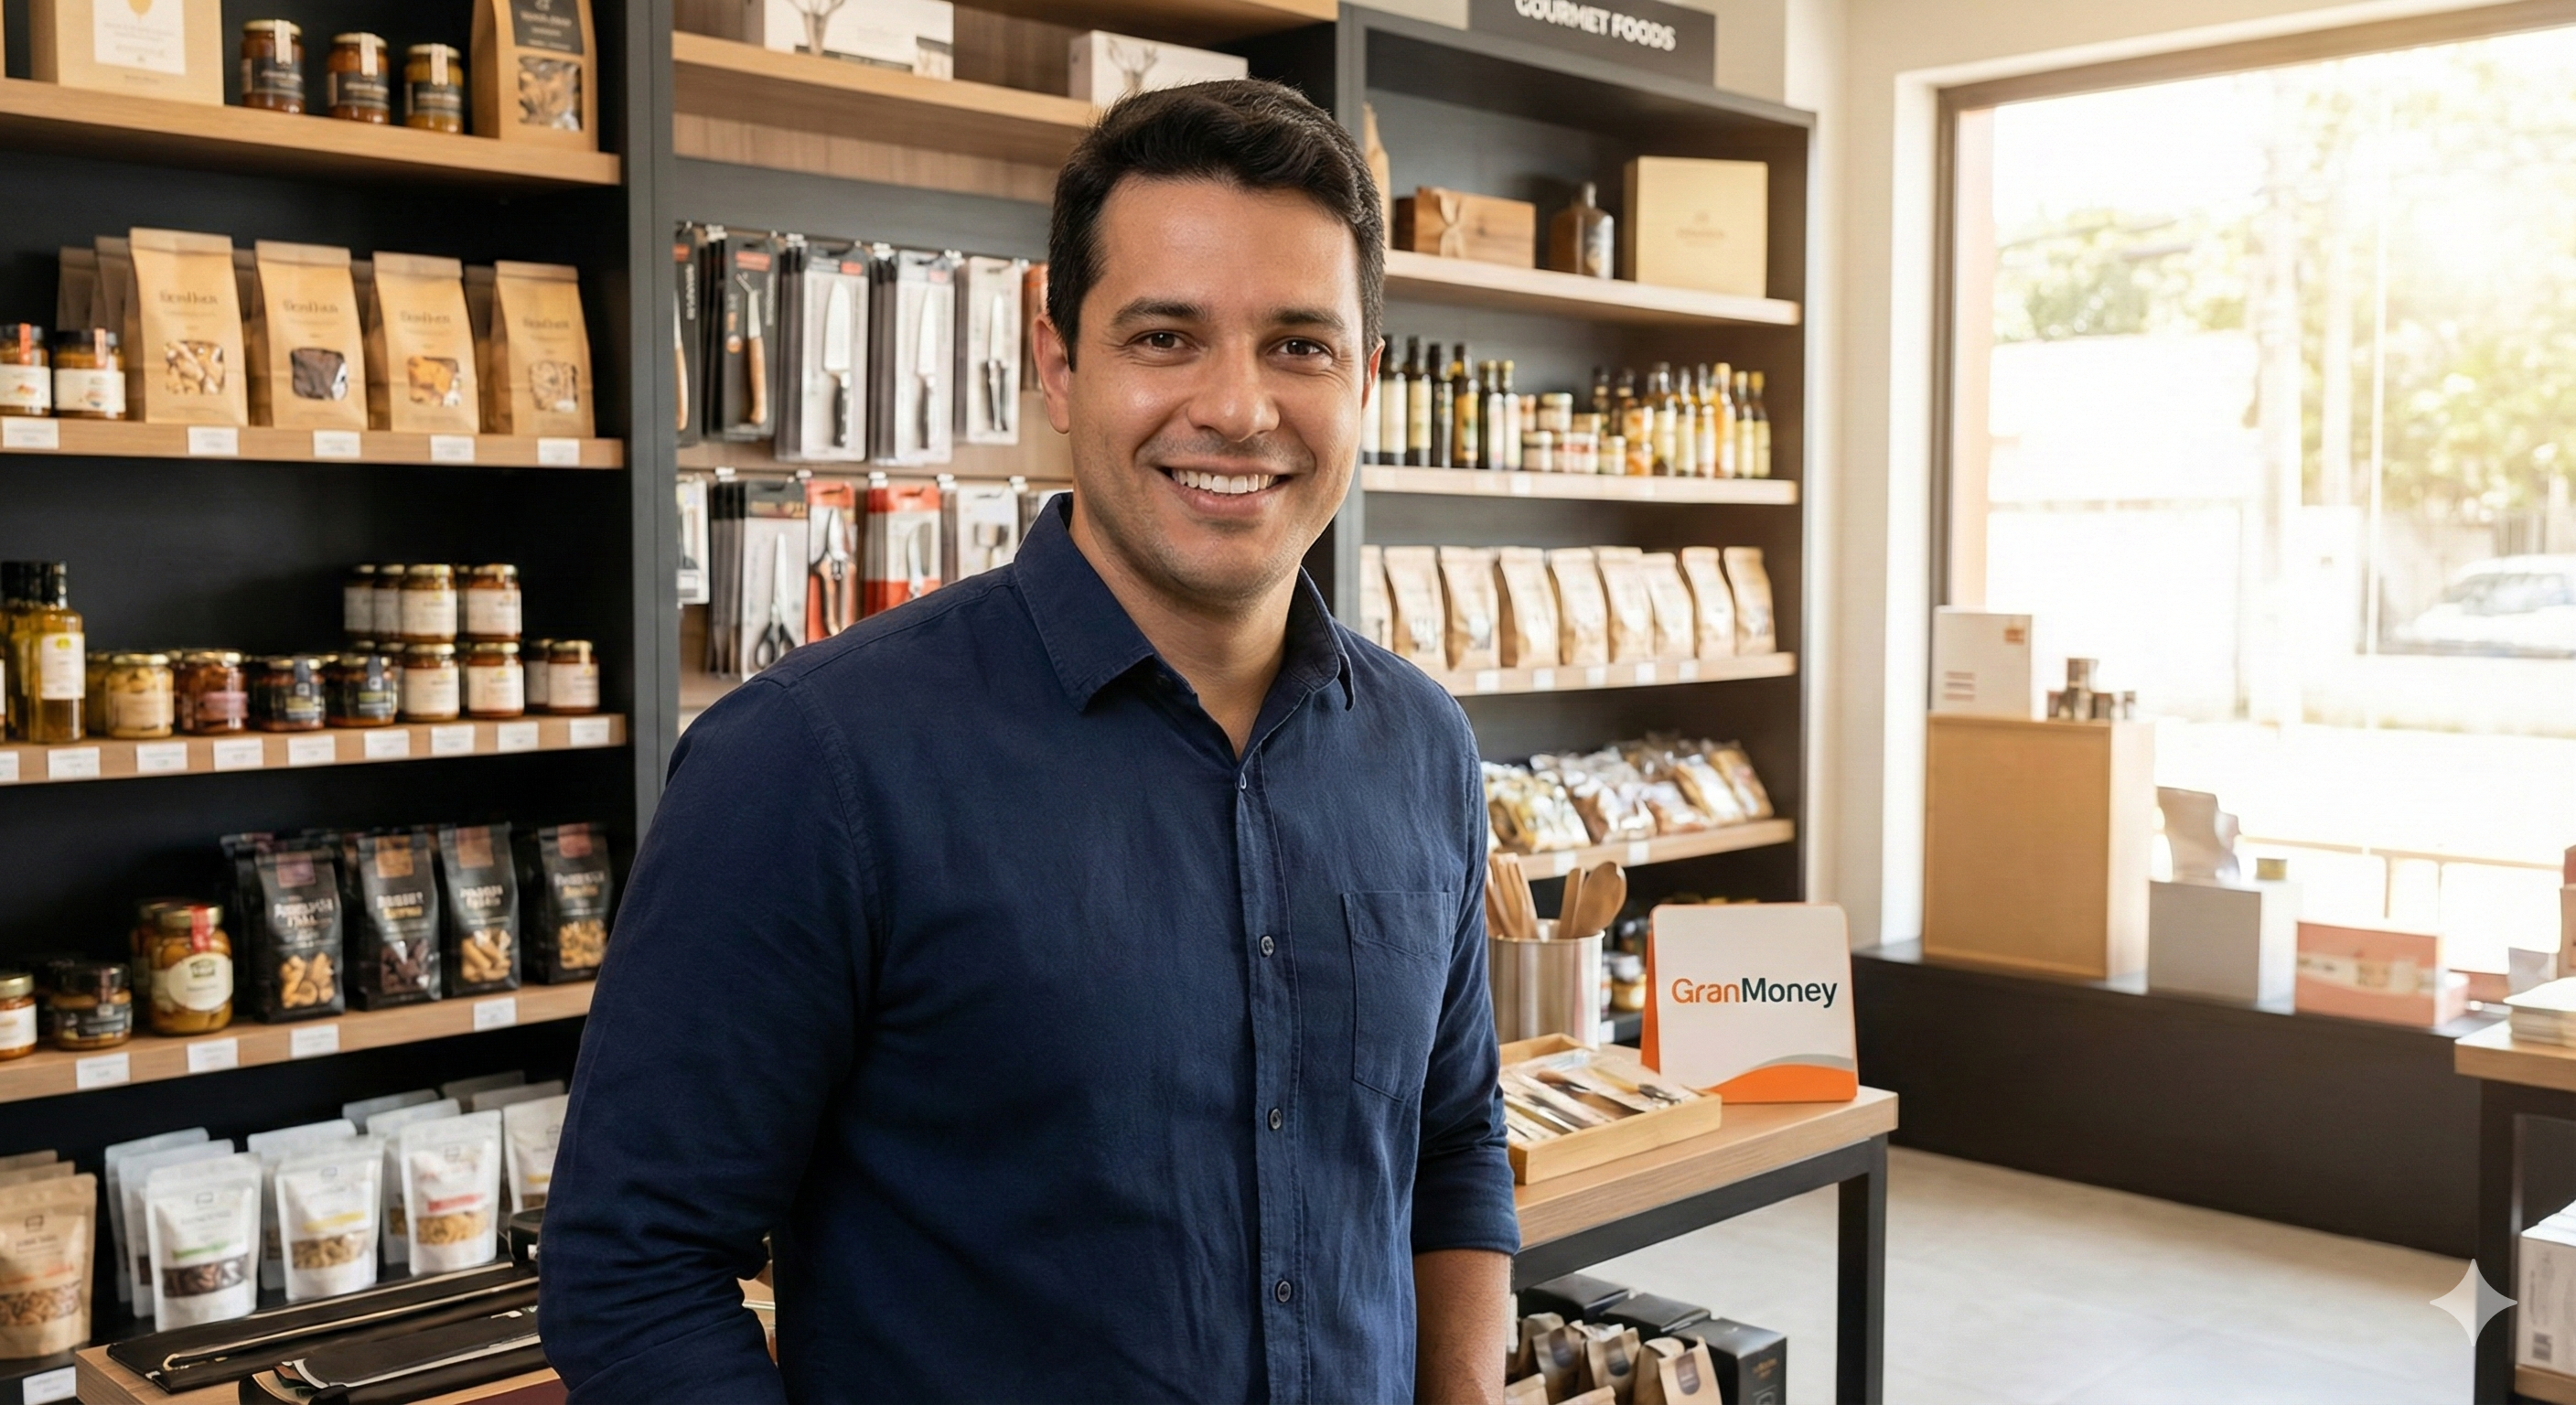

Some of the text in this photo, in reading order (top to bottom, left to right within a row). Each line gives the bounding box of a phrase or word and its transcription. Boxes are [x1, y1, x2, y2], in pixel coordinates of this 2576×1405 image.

[1515, 0, 1677, 51] GOURMET FOODS
[1671, 977, 1838, 1009] GranMoney
